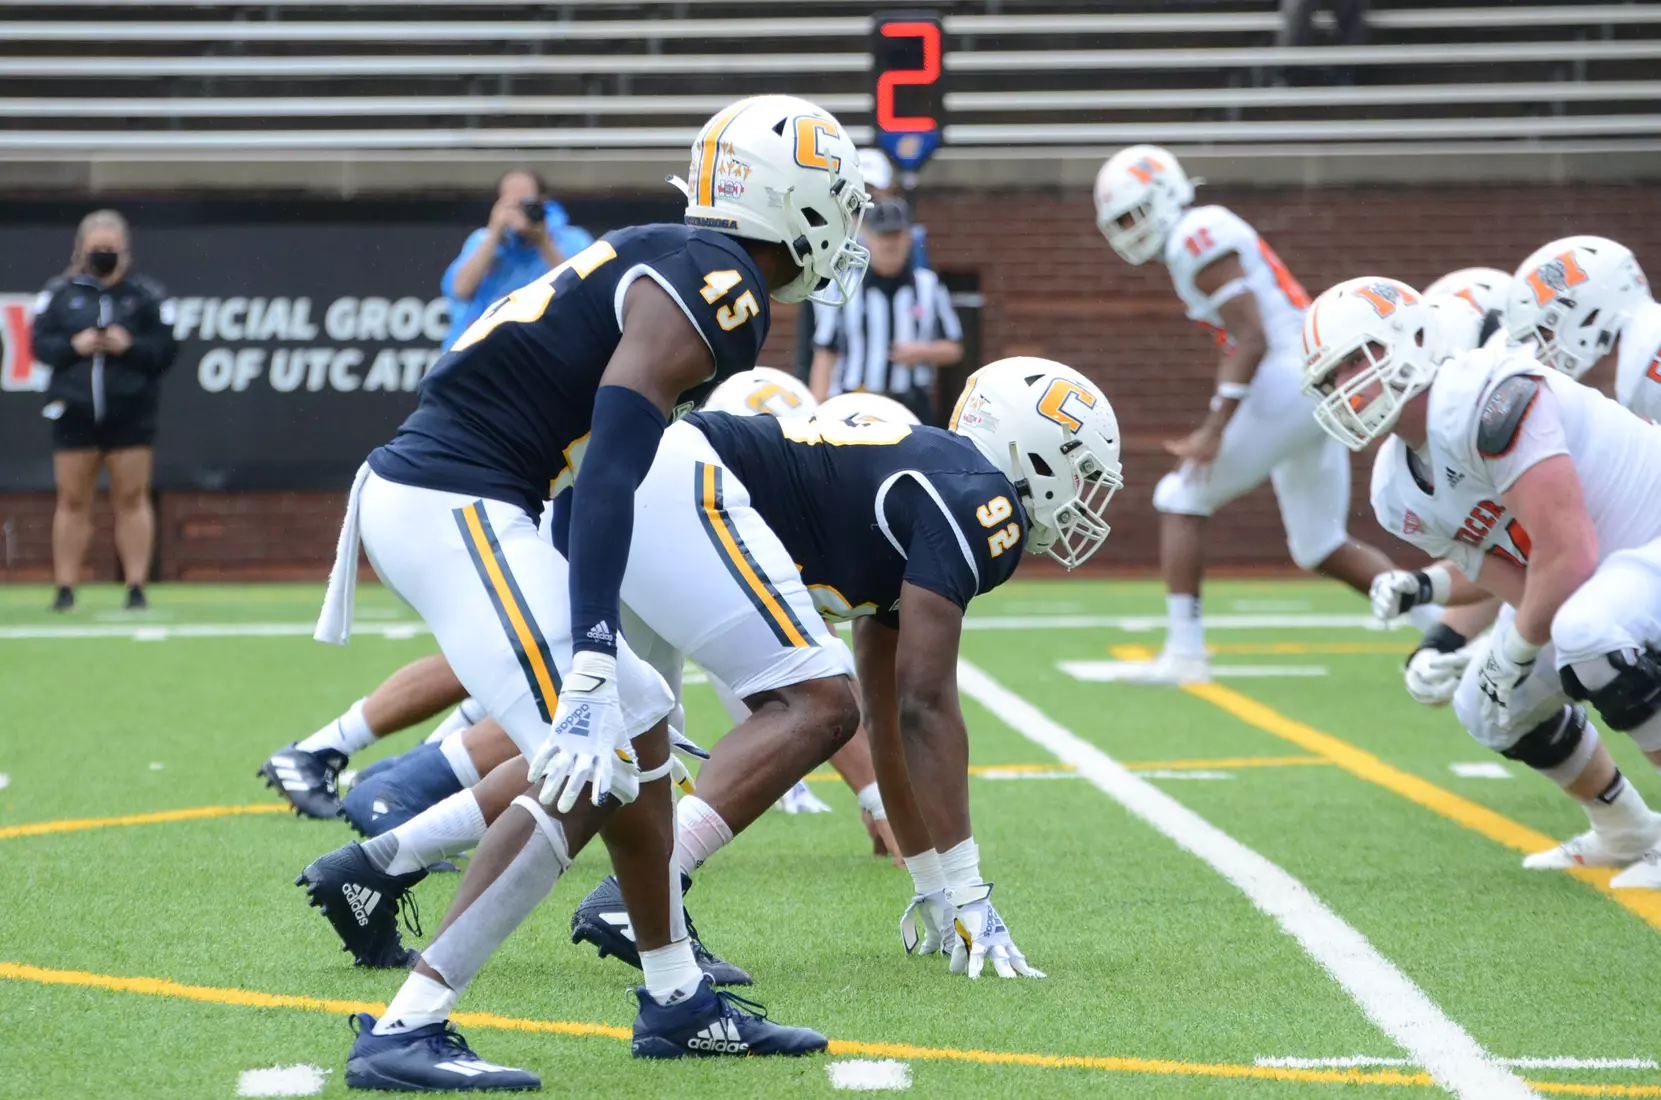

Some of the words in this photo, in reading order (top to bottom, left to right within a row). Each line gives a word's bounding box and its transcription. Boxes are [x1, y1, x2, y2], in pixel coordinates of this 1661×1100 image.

[877, 21, 941, 132] 2
[793, 115, 841, 174] C
[170, 297, 319, 341] FICIAL
[699, 269, 760, 331] 45
[198, 347, 267, 393] OF
[269, 347, 365, 393] UTC
[975, 495, 1020, 558] 92
[586, 630, 613, 641] adidas
[554, 702, 589, 736] adidas
[341, 883, 369, 927] adidas
